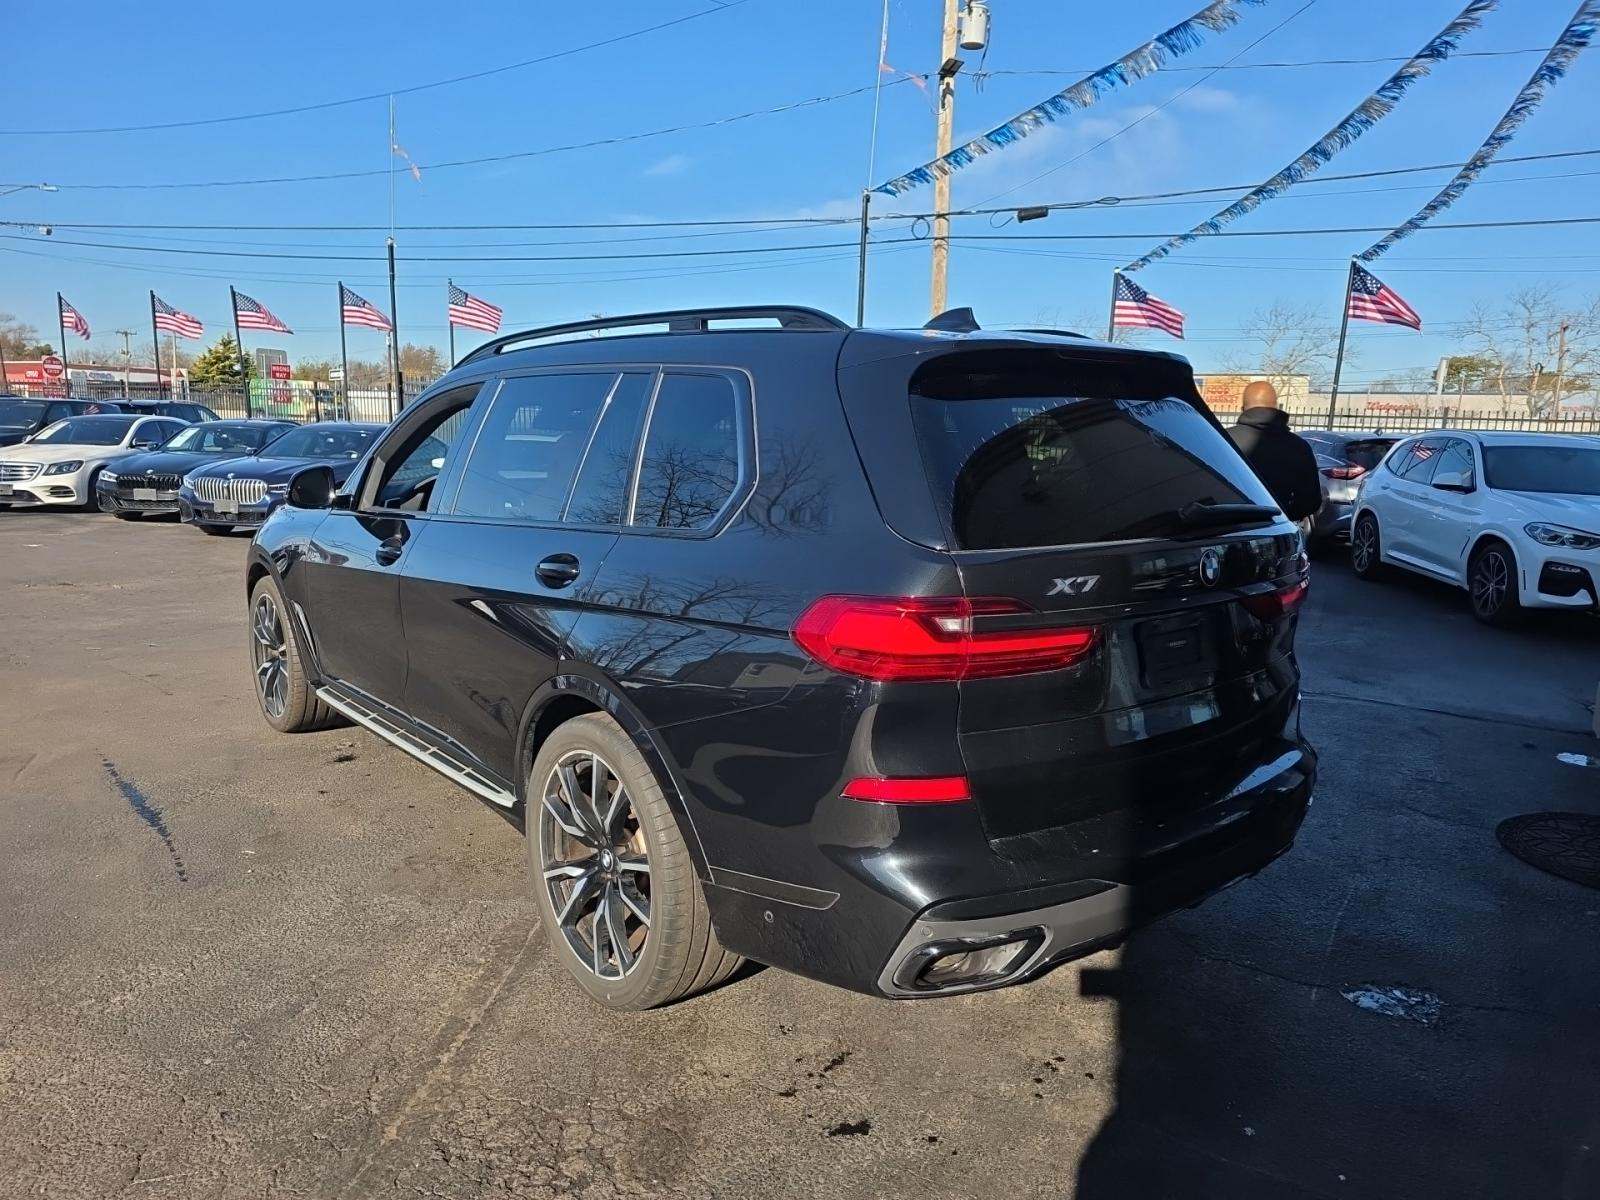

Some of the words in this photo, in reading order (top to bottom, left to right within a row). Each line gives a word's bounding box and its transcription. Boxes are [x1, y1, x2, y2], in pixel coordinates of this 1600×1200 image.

[1207, 385, 1229, 395] FOOD
[1367, 401, 1419, 413] Walgreens
[1045, 575, 1101, 596] X7
